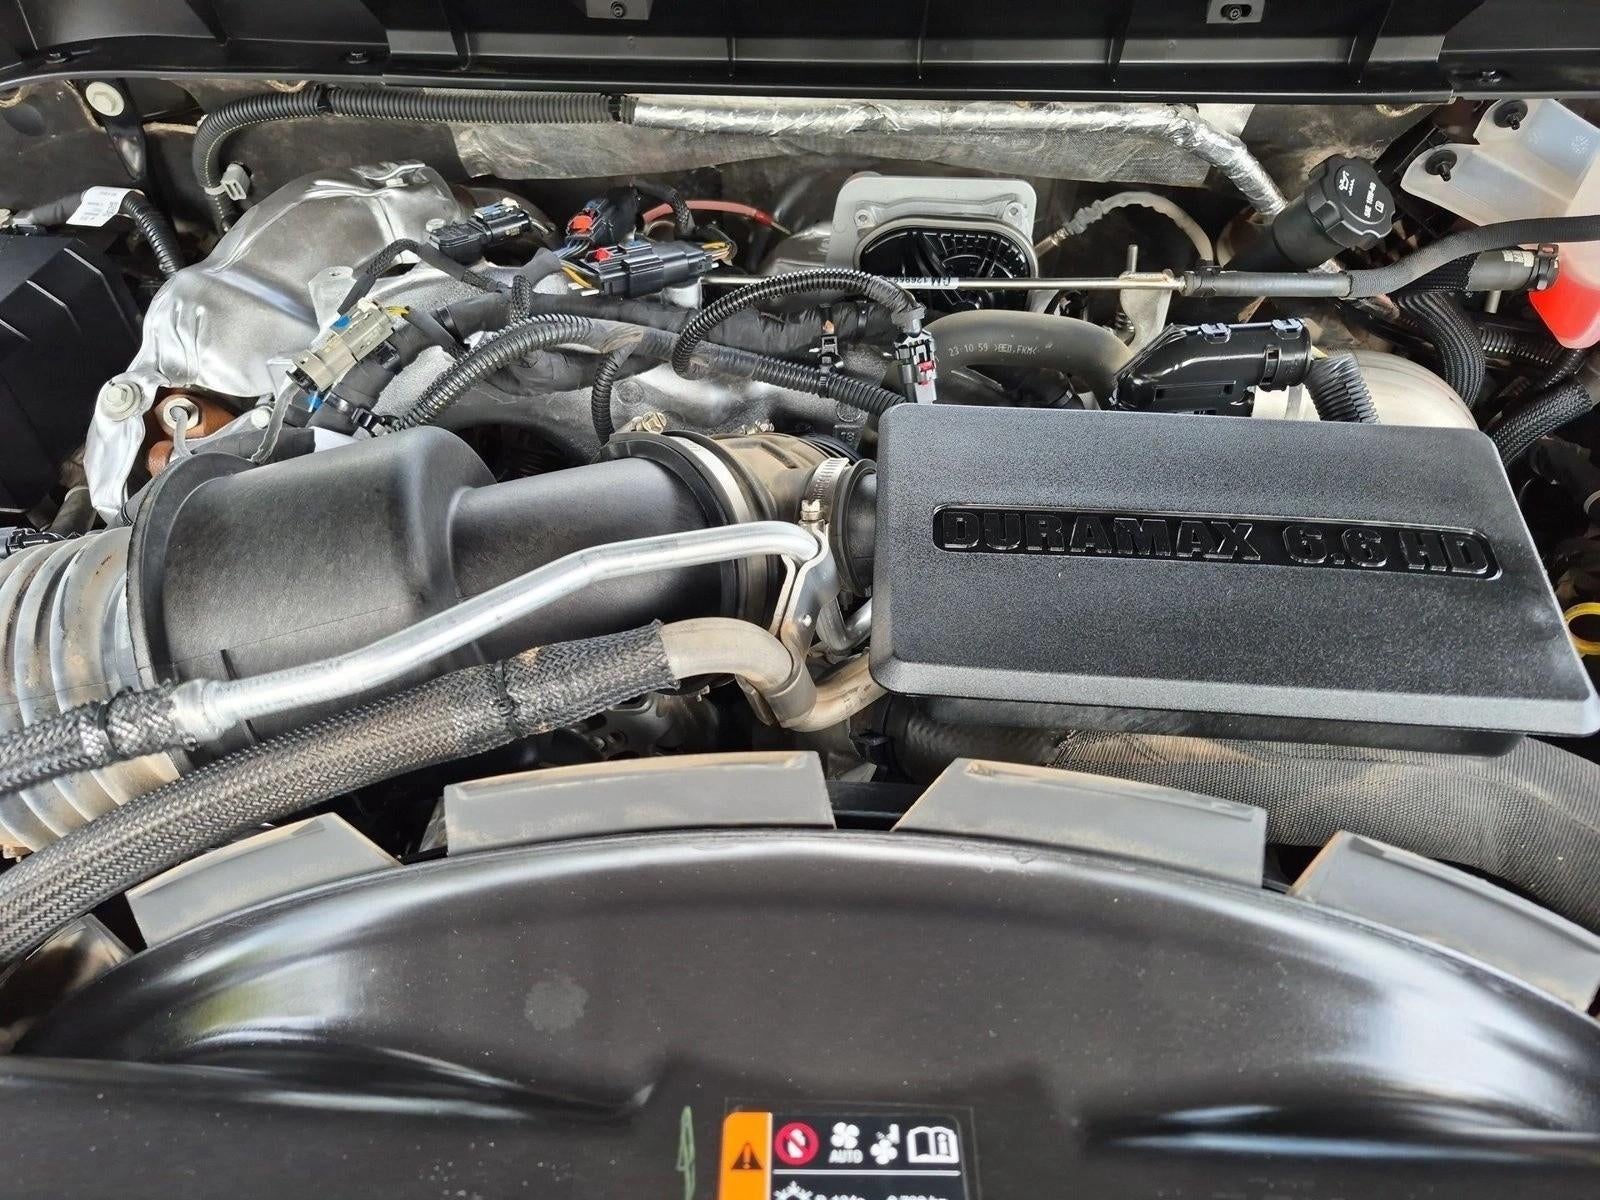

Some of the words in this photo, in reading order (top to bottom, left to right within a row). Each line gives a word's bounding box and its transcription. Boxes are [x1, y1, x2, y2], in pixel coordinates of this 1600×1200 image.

[942, 511, 1261, 560] DURAMAX
[1282, 524, 1389, 568] 6.6
[1399, 530, 1489, 575] HD
[828, 1149, 864, 1164] AUTO
